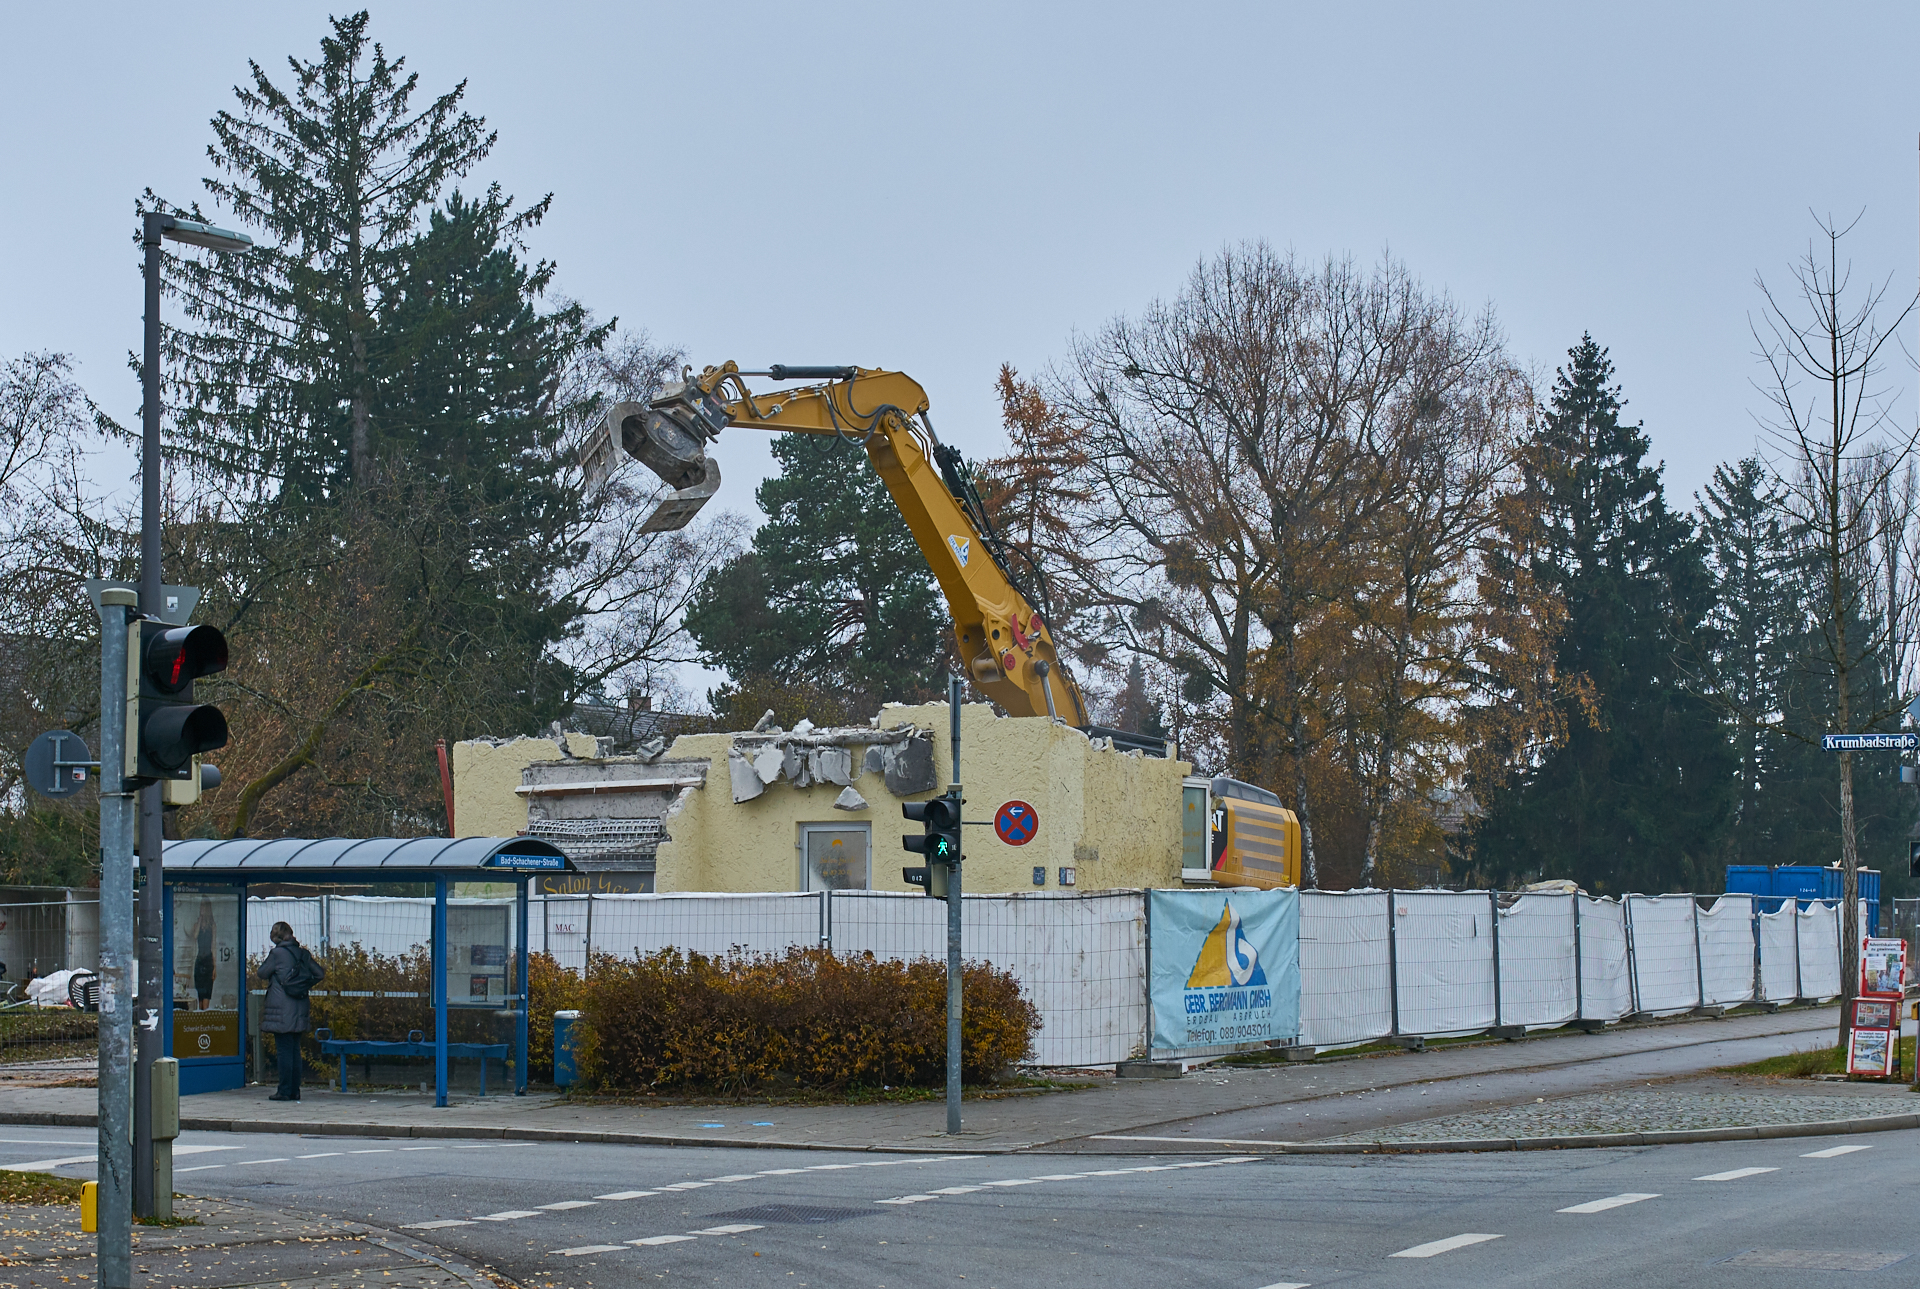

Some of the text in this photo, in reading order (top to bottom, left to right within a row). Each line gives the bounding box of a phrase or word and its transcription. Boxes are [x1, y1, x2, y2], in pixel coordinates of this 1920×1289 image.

[1826, 735, 1915, 749] Krumbadstraße
[500, 856, 559, 867] Bad-Schachener-Straße
[543, 875, 592, 894] Salon
[555, 923, 575, 932] MAC
[1184, 988, 1271, 1014] GEBR. BERGMANN GMBH
[1187, 1010, 1271, 1025] ERDBAU ABBRUCH
[1187, 1023, 1271, 1042] Telefon: 089/9043011
